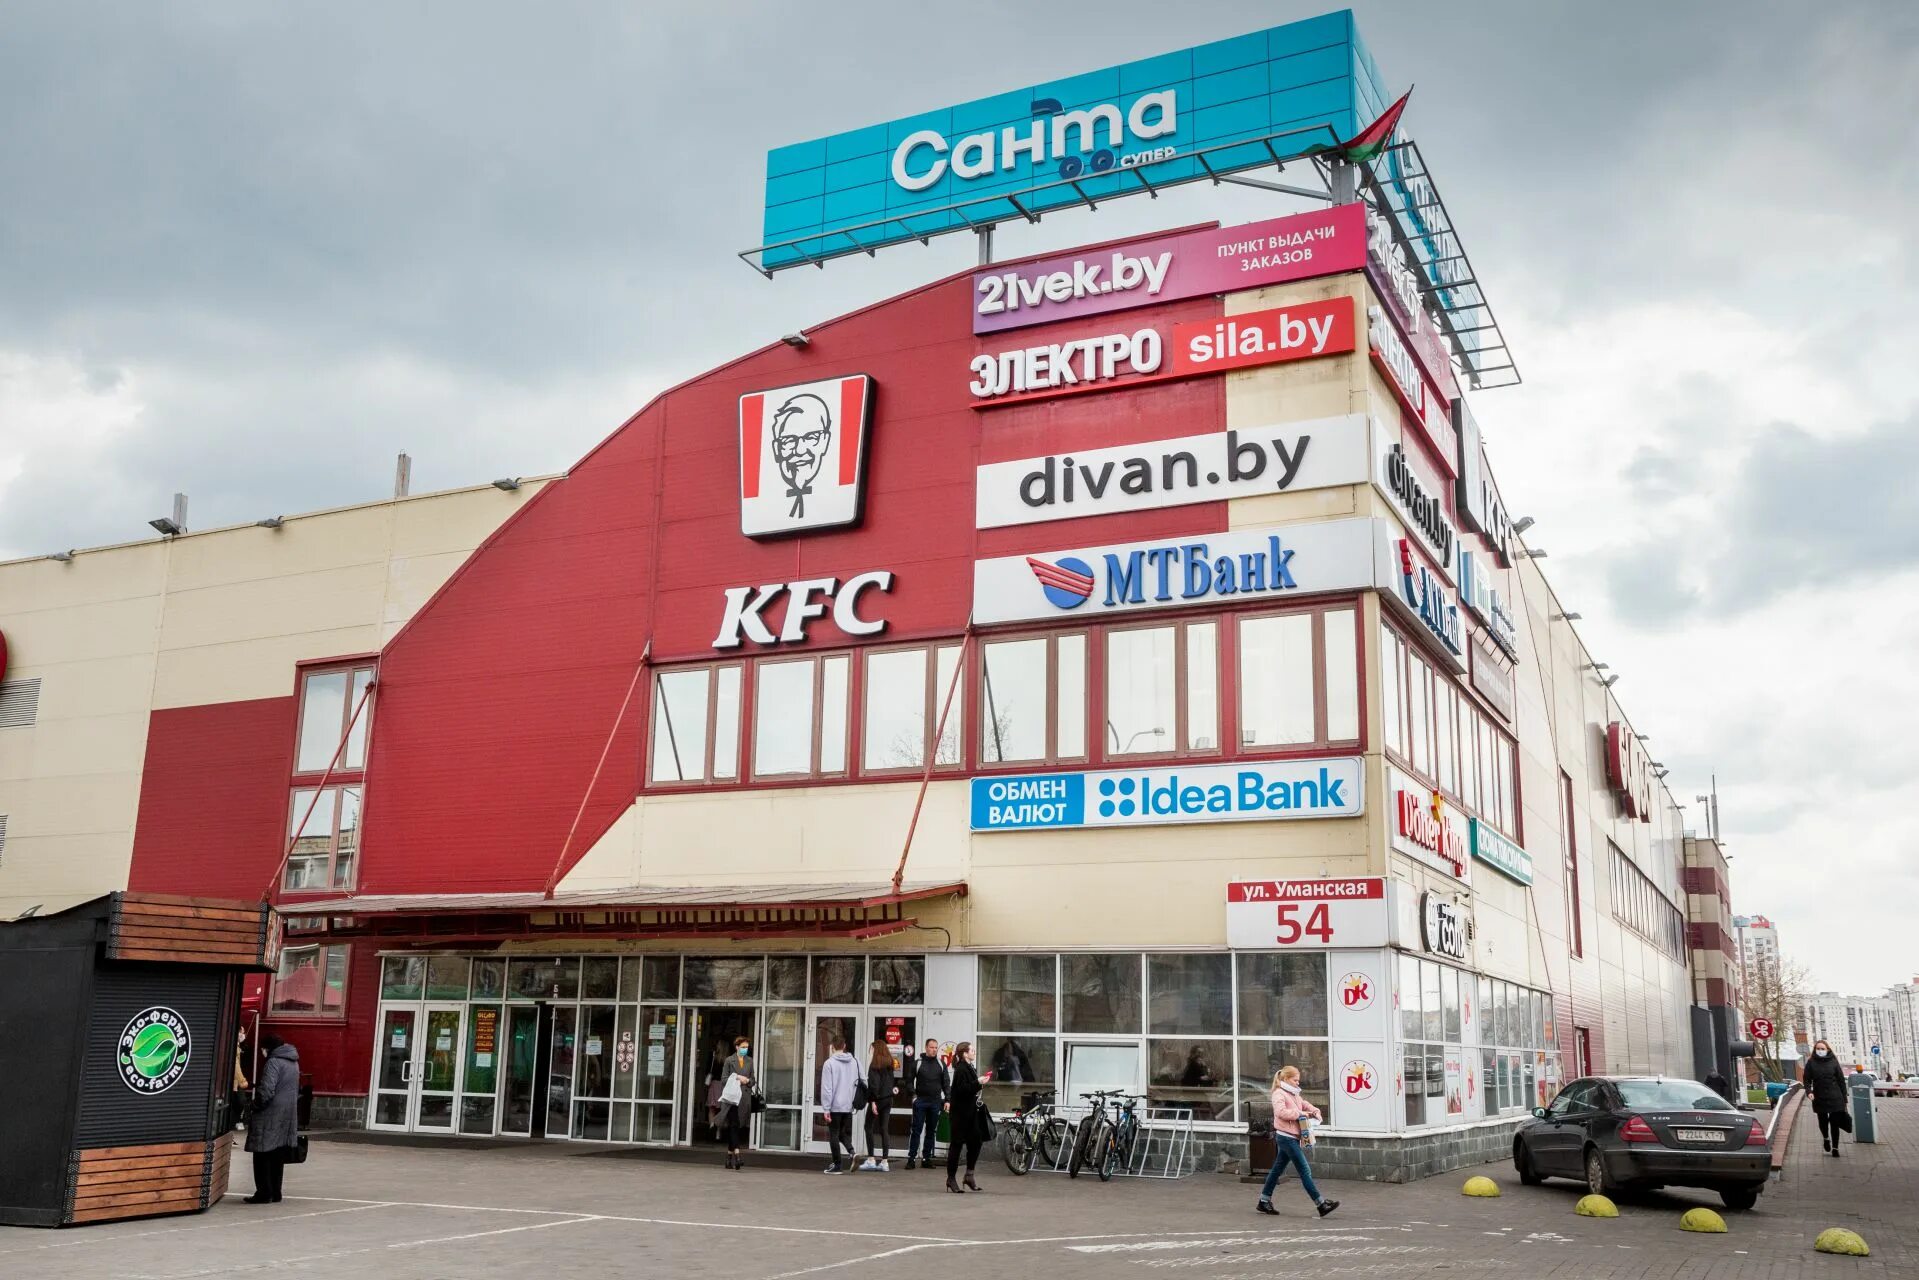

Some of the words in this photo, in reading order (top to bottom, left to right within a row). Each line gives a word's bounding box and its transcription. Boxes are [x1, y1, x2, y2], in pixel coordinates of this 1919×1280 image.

[891, 88, 1177, 192] Санта
[1120, 146, 1176, 168] СУПЕР
[1216, 238, 1266, 258] ПУНКТ
[1267, 226, 1337, 250] ВЫДАЧИ
[1240, 248, 1314, 273] ЗАКАЗОВ
[976, 250, 1174, 316] 21vek.by
[1189, 309, 1335, 364] sila.by
[969, 327, 1162, 398] ЭЛЕКТРО
[1019, 429, 1312, 508] divan.by
[1102, 535, 1298, 606] МТБанк
[710, 570, 897, 650] KFC
[988, 779, 1067, 802] ОБМЕН
[988, 802, 1068, 825] ВАЛЮТ
[1242, 886, 1270, 901] ул.
[1275, 880, 1368, 898] Уманская
[1276, 903, 1335, 945] 54
[1343, 982, 1369, 1006] DK
[122, 1010, 187, 1048] Эко-ферма
[125, 1064, 182, 1090] eco-farm
[1346, 1073, 1372, 1094] DK
